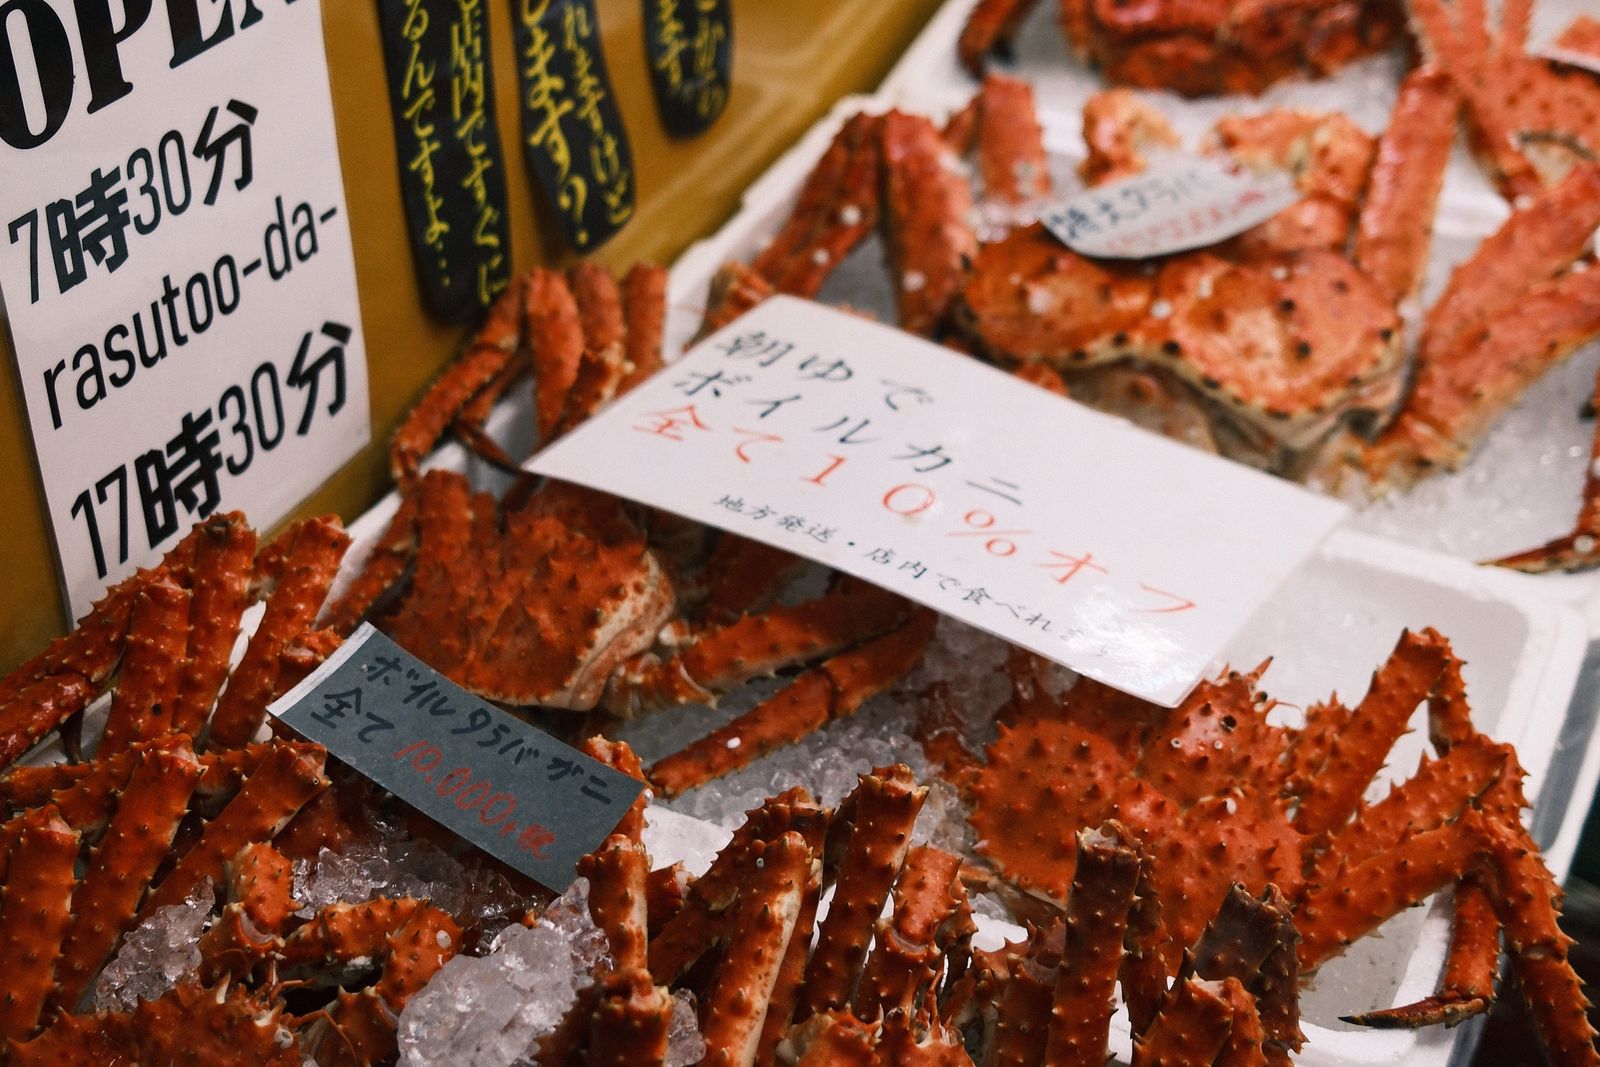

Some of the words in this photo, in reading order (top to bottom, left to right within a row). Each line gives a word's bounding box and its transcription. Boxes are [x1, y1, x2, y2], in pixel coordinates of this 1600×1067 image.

[0, 0, 297, 149] OPE
[8, 99, 258, 304] 7時30分
[43, 195, 338, 430] rasutoo-da-
[716, 331, 934, 411] 朝ゆで
[71, 321, 352, 579] 17時30分
[673, 370, 1022, 505] ボイルカニ
[714, 494, 1107, 657] 地方発送・店内で食べれ
